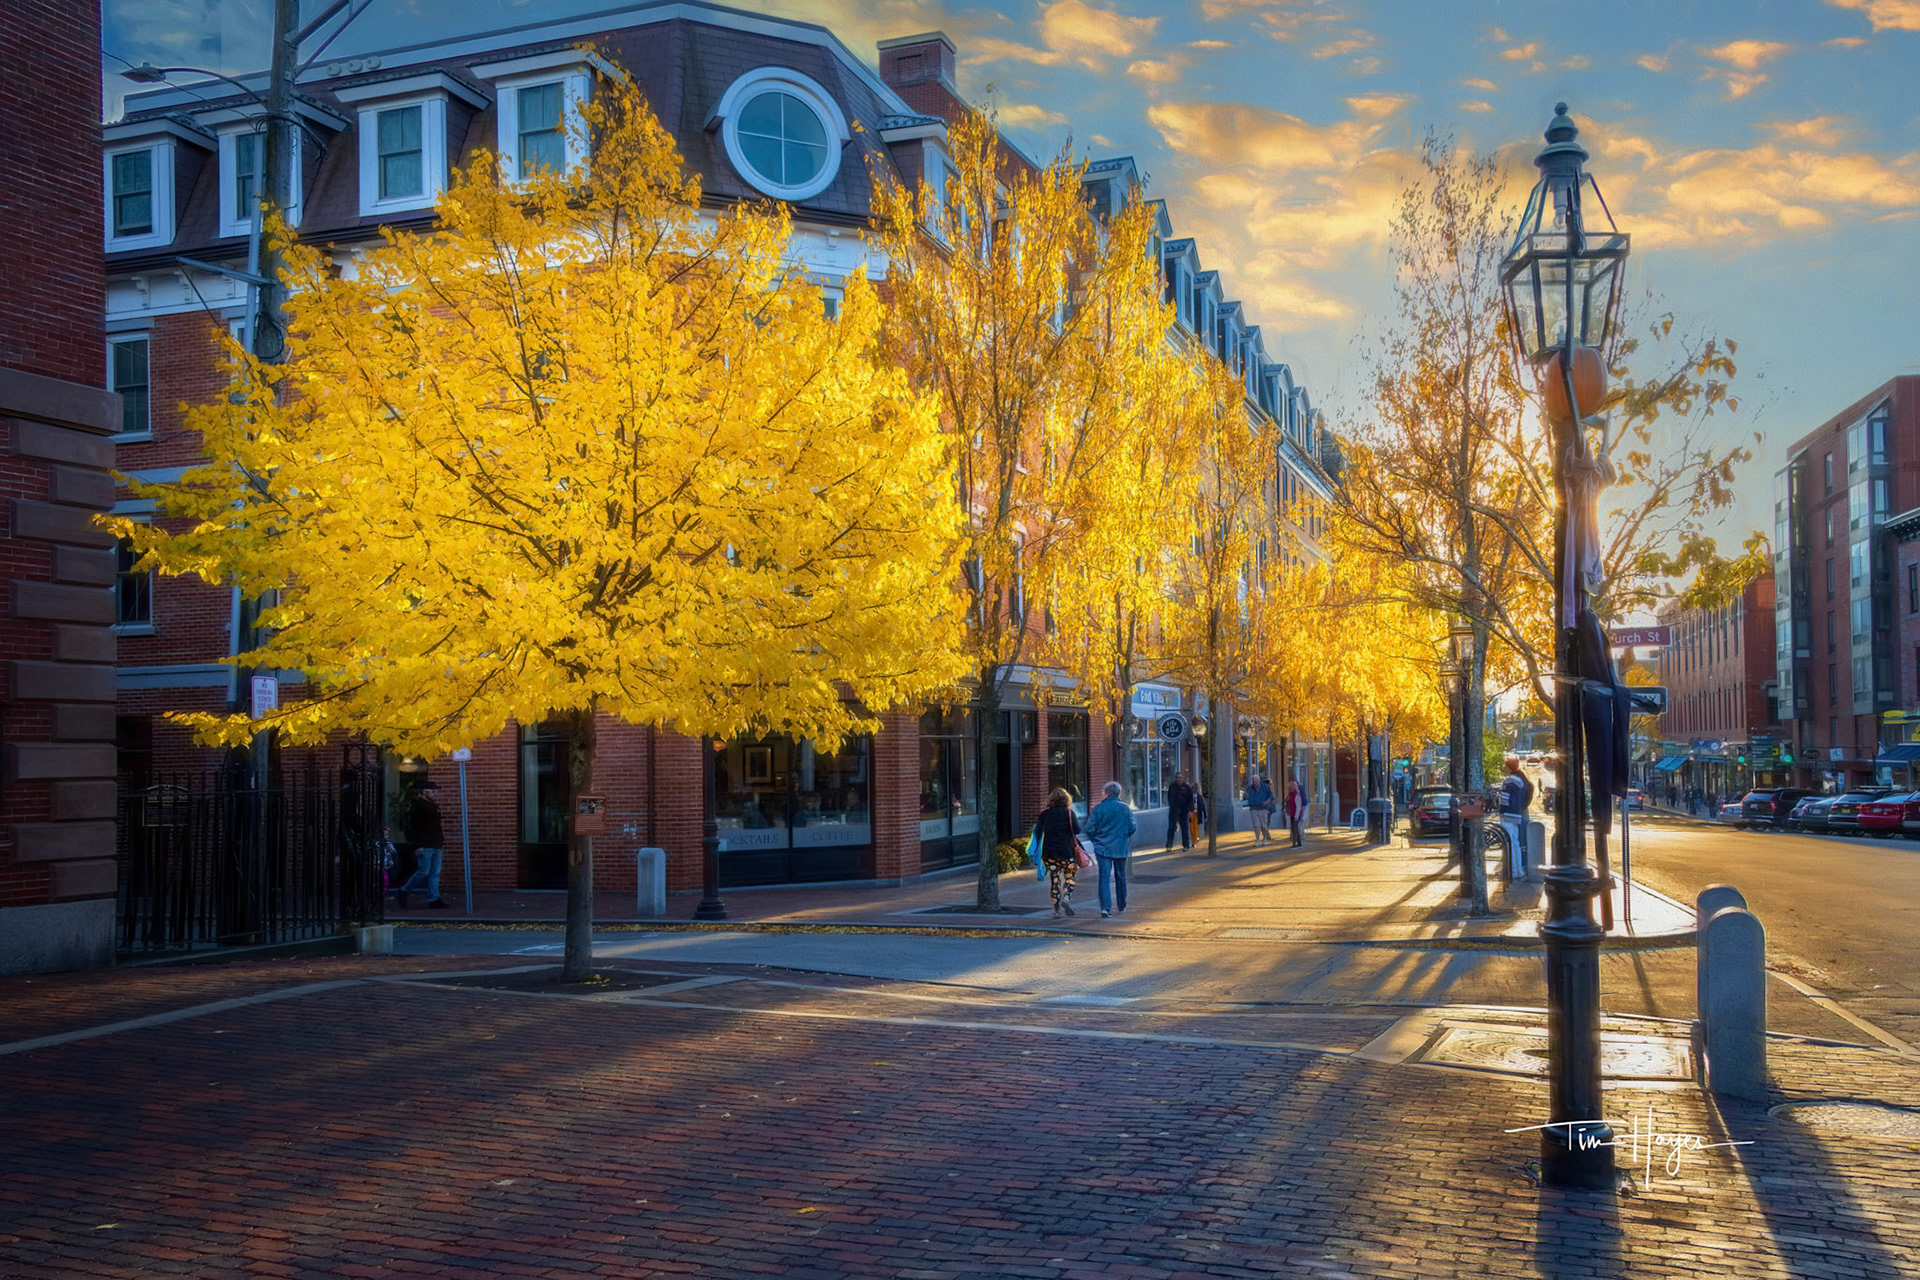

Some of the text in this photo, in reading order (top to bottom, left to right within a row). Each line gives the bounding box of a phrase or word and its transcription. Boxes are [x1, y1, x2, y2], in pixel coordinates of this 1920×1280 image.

[1647, 631, 1660, 643] St
[728, 831, 856, 846] OCKTAILS COFFEE
